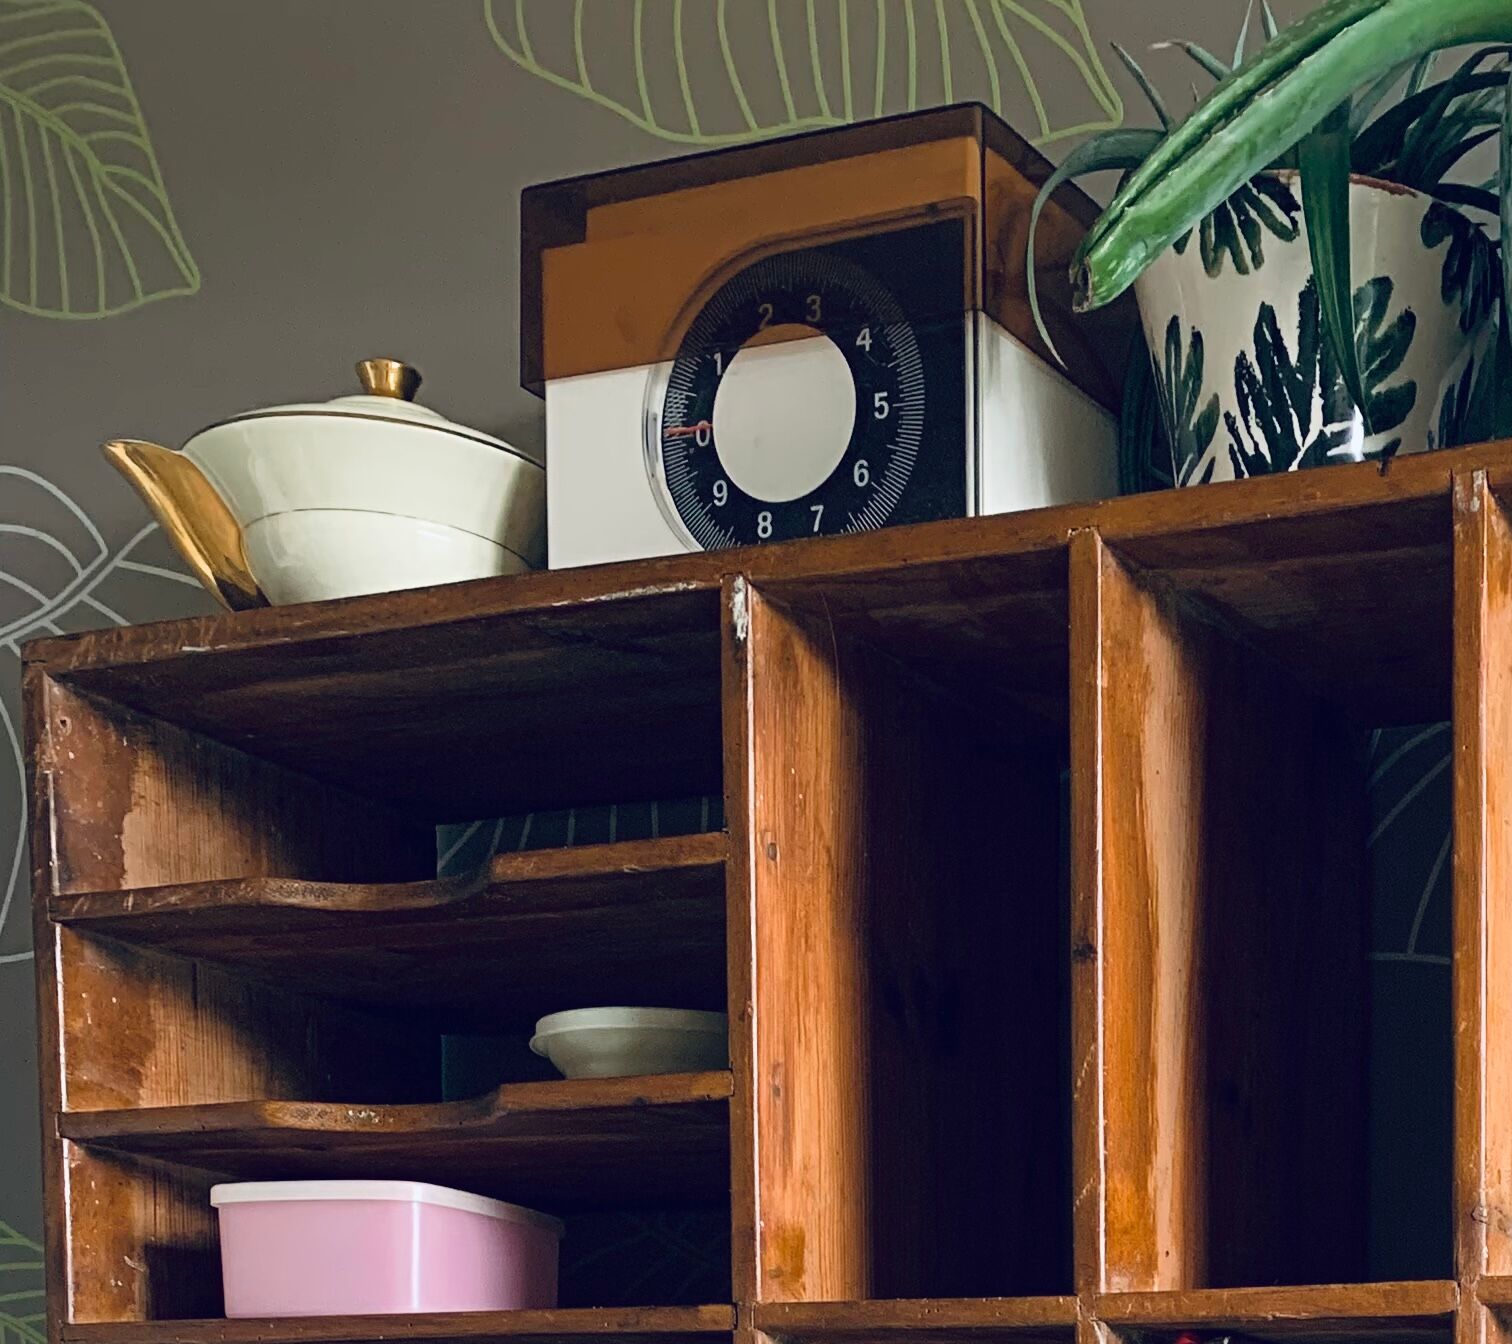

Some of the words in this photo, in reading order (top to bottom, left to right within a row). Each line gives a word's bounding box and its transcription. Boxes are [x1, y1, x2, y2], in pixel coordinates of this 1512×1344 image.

[757, 303, 774, 329] 2
[805, 295, 822, 322] 3
[855, 327, 873, 352] 4
[713, 351, 723, 376] 1
[873, 391, 890, 419] 5
[695, 419, 711, 447] 0
[852, 459, 870, 487] 6
[712, 479, 729, 506] 9
[757, 511, 773, 539] 8
[810, 504, 825, 532] 7
